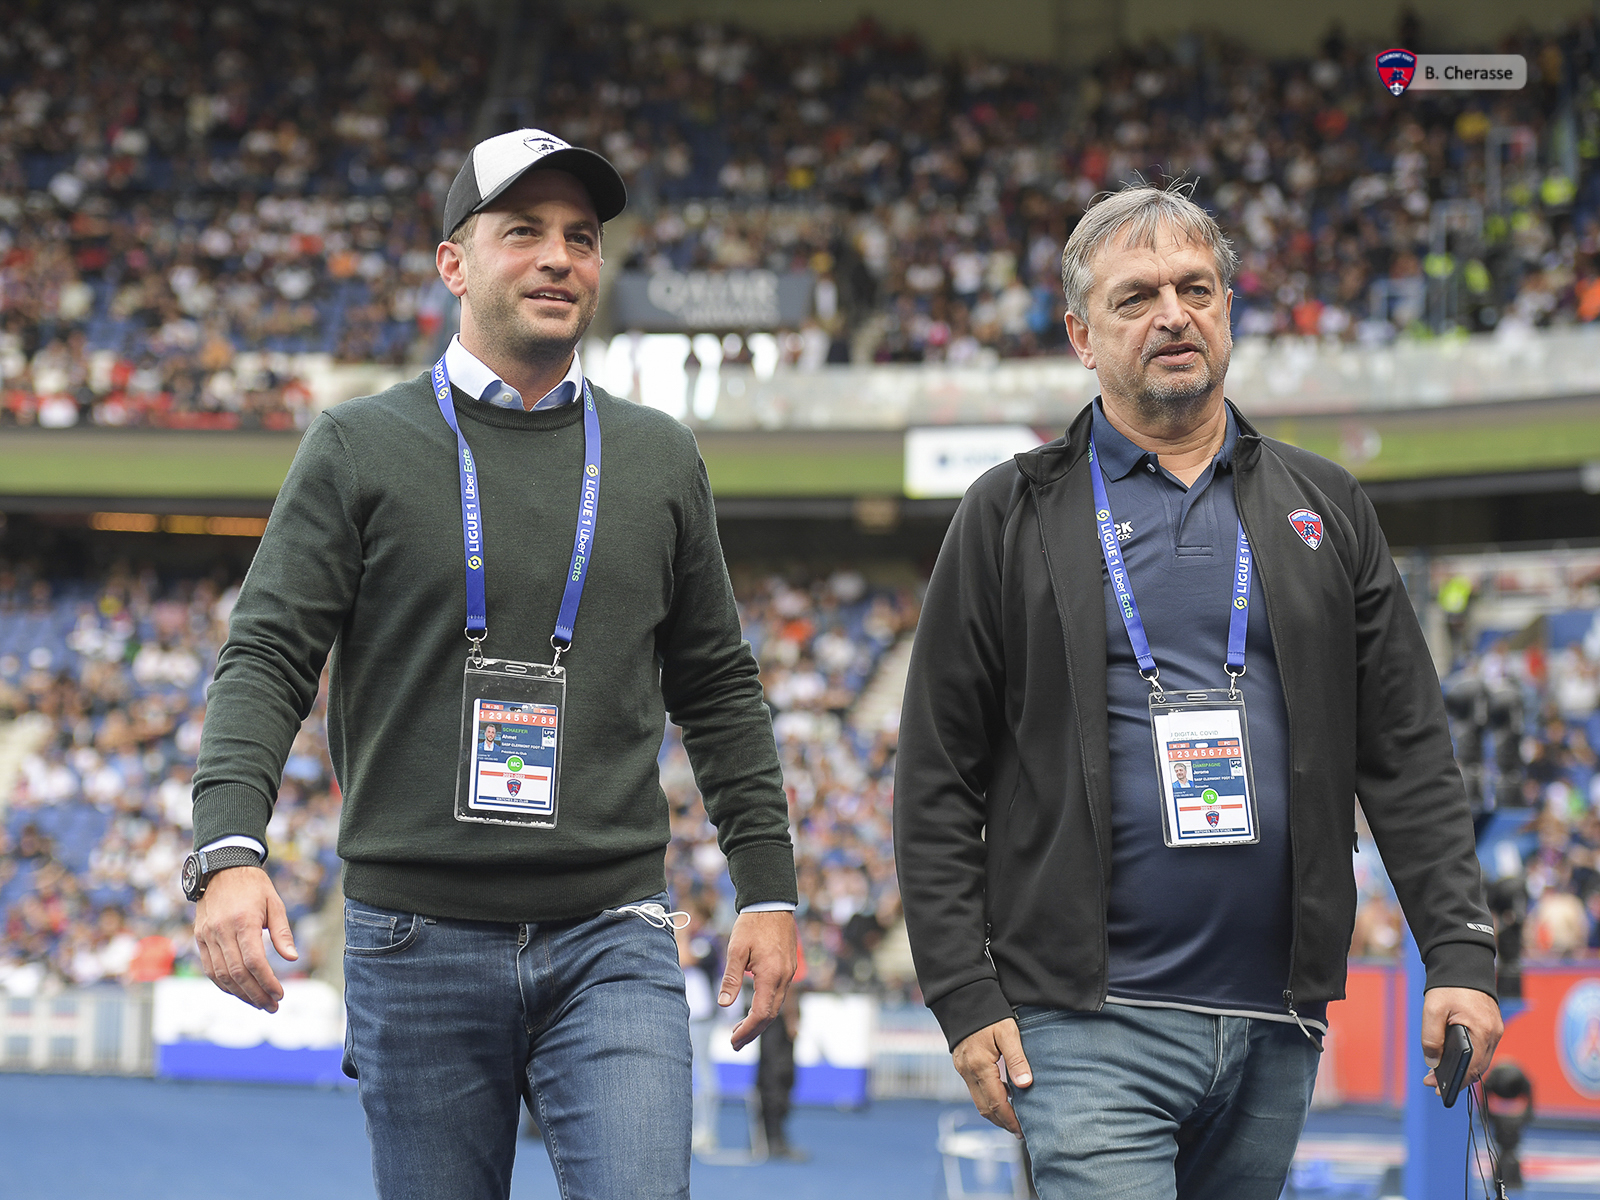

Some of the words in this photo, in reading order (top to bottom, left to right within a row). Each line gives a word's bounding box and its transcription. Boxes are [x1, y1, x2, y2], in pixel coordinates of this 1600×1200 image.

[463, 448, 473, 473] Eats
[465, 474, 476, 500] Uber
[582, 479, 596, 517] LIGUE
[467, 512, 480, 552] LIGUE
[577, 528, 591, 555] Uber
[1100, 522, 1120, 558] LIGUE
[1110, 558, 1120, 566] 1
[1240, 547, 1250, 555] 1
[571, 555, 585, 582] Eats
[1112, 568, 1126, 593] Uber
[1236, 556, 1250, 594] LIGUE
[1120, 593, 1134, 619] Eats
